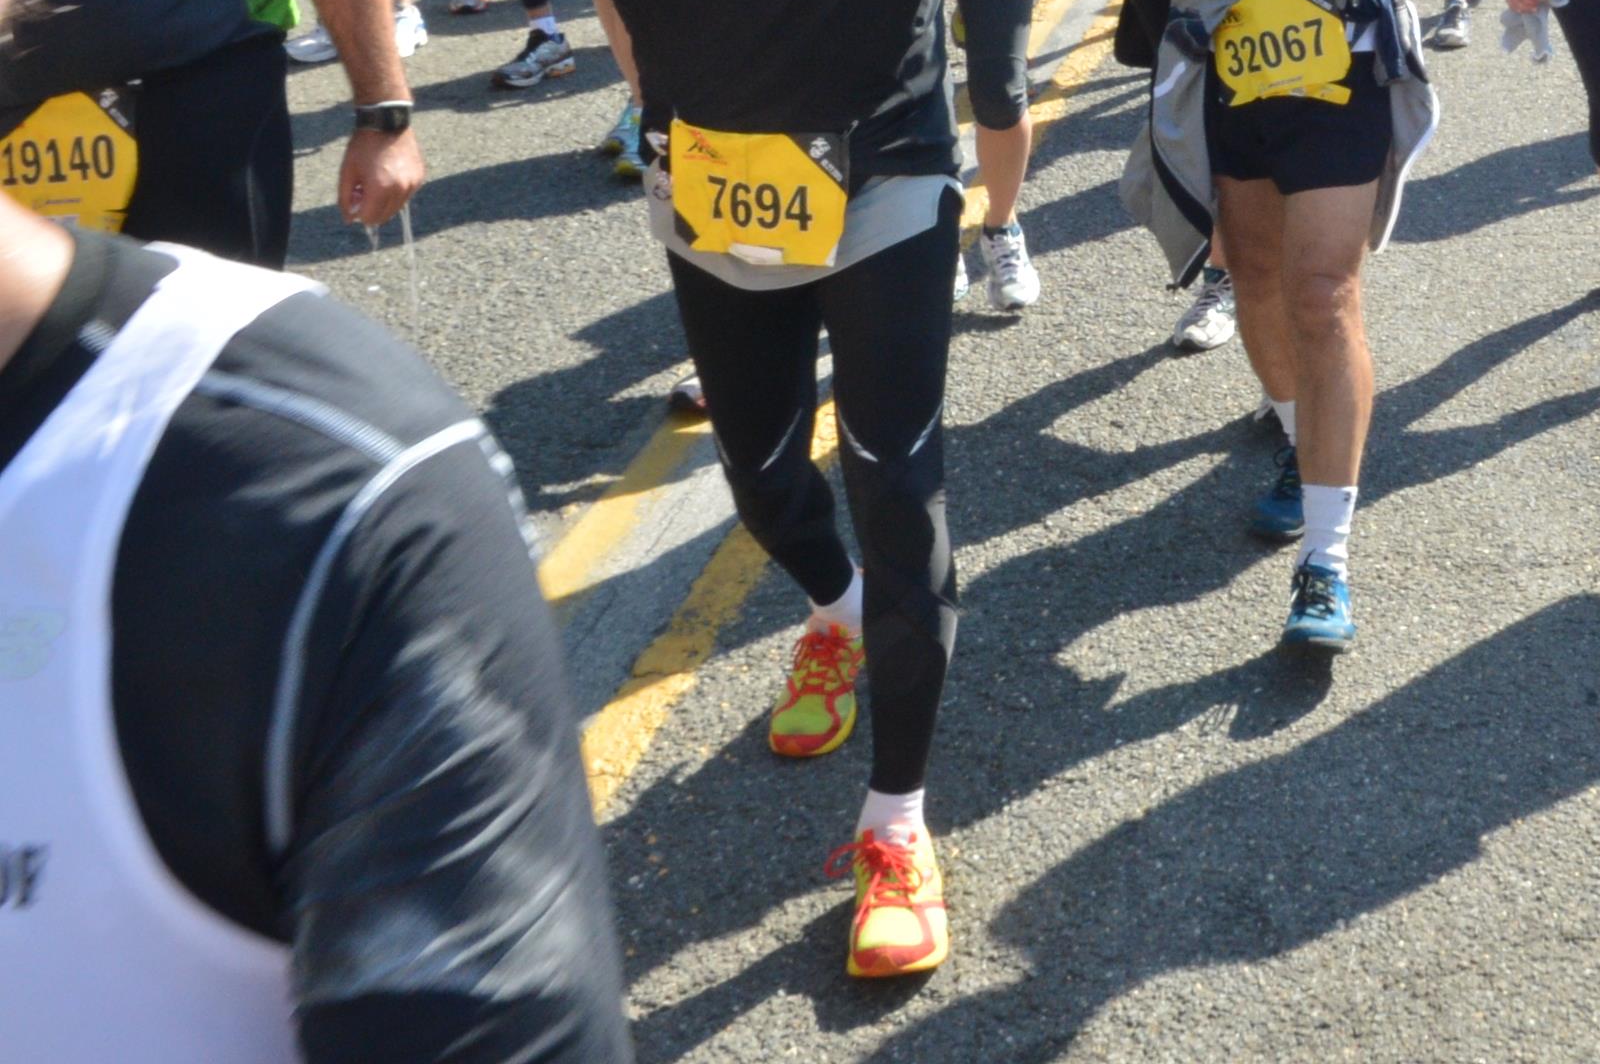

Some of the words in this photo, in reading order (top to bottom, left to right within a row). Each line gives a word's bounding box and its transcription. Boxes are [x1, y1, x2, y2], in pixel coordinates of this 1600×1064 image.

[1224, 18, 1323, 76] 32067
[2, 134, 115, 186] 19140
[708, 175, 812, 232] 7694
